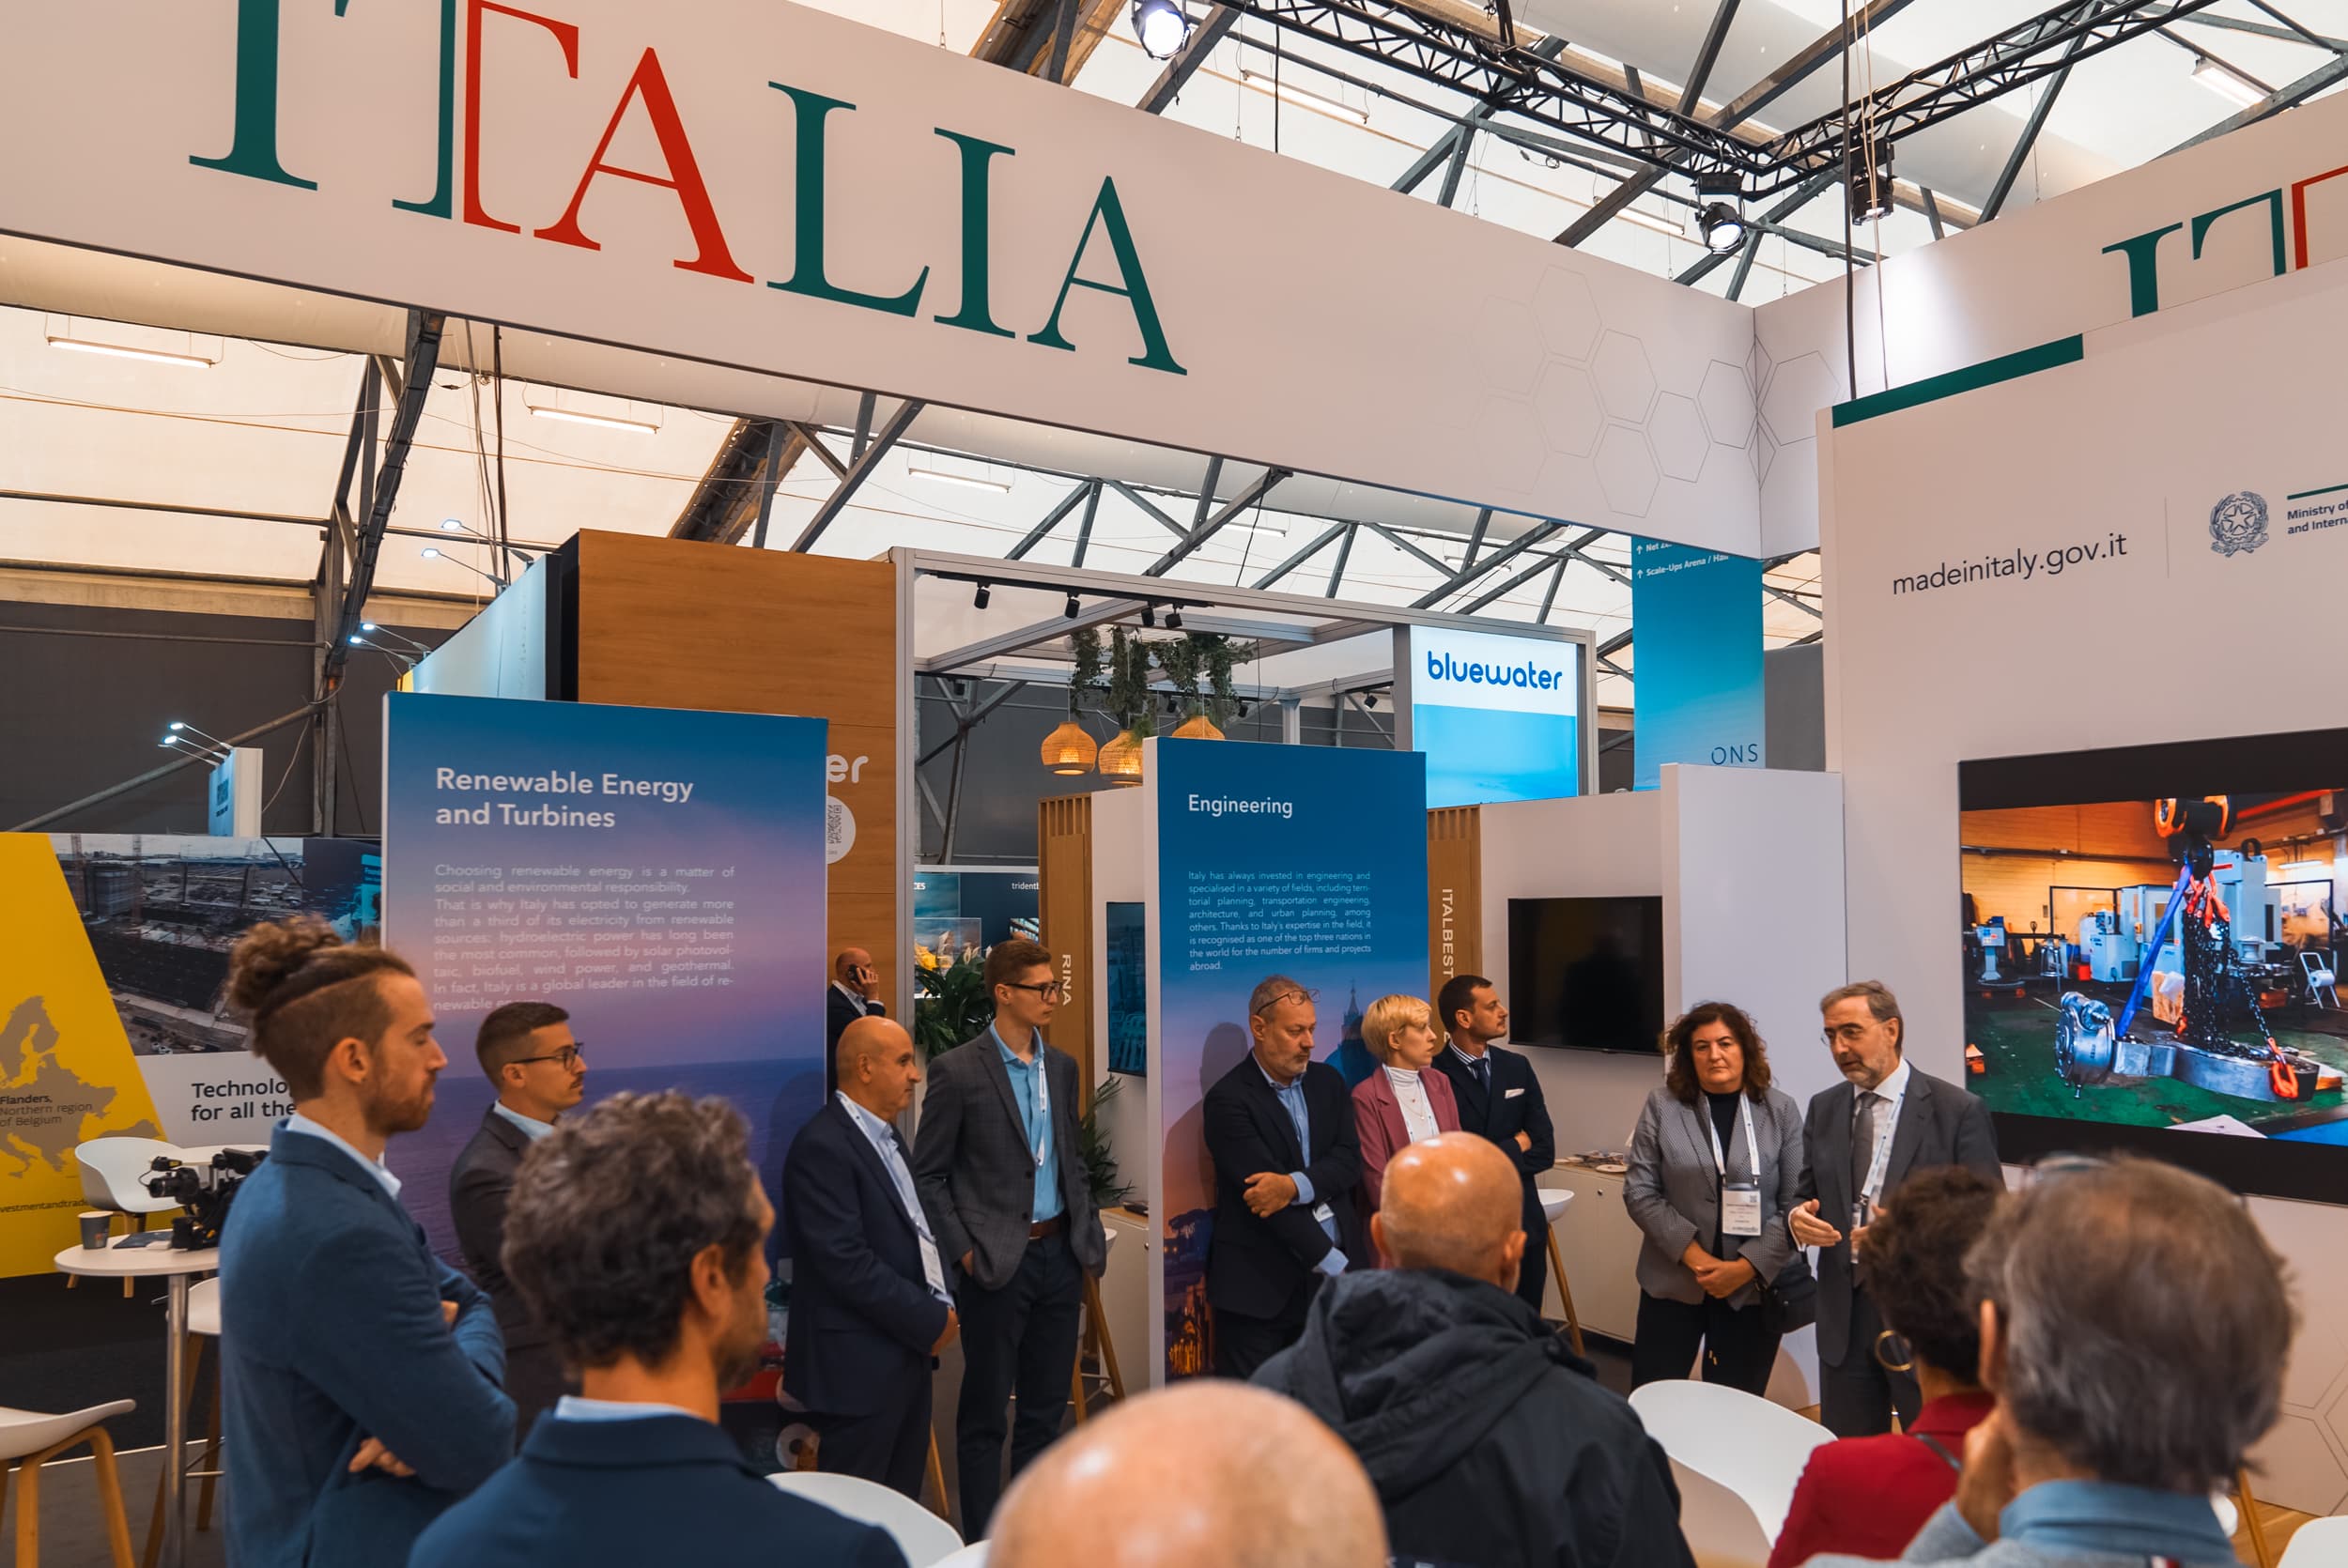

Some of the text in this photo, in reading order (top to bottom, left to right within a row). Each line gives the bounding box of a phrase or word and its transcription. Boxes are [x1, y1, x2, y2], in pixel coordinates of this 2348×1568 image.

[189, 0, 1187, 377] ITALIA
[2287, 503, 2335, 520] Ministry
[2287, 522, 2309, 534] and
[1645, 561, 1682, 576] Scale-Ups
[1684, 557, 1707, 568] Arena
[1892, 532, 2127, 595] madeinitaly.gov.it
[1428, 650, 1563, 690] bluewater
[1711, 743, 1758, 765] ONS
[436, 767, 694, 803] Renewable Energy
[1188, 794, 1293, 819] Engineering
[436, 802, 615, 828] and Turbines
[435, 864, 735, 879] Choosing renewable energy is a matter of
[1188, 871, 1370, 883] Italy has always invested in engineering and
[435, 881, 690, 895] social and environmental responsibility.
[1188, 883, 1235, 895] specialised
[1253, 884, 1280, 894] variety
[1281, 884, 1290, 892] of
[1316, 883, 1352, 894] including
[435, 898, 734, 913] That is why Italy has opted to generate more
[1188, 896, 1211, 906] torial
[1262, 897, 1317, 906] transportation
[435, 914, 734, 928] than a third of its electricity from renewable
[1247, 909, 1263, 917] and
[1271, 909, 1294, 917] urban
[1345, 909, 1371, 918] among
[1220, 921, 1249, 930] Thanks
[1285, 921, 1321, 930] expertise
[500, 930, 586, 945] hydroelectric
[594, 931, 634, 945] power
[641, 930, 662, 941] has
[669, 929, 697, 943] long
[703, 929, 734, 940] been
[1198, 934, 1244, 946] recognised
[1274, 933, 1283, 943] of
[1285, 932, 1297, 942] the
[1299, 933, 1312, 943] top
[1314, 931, 1334, 941] three
[433, 944, 734, 961] the most common, followed by solar photovol-
[1189, 945, 1371, 958] the world for the number of firms and projects
[533, 962, 565, 975] wind
[629, 961, 652, 973] and
[1190, 961, 1223, 971] abroad.
[433, 983, 447, 993] In
[484, 980, 513, 994] Italy
[517, 981, 526, 992] is
[530, 982, 538, 992] a
[543, 978, 584, 993] global
[588, 977, 629, 990] leader
[632, 977, 644, 987] in
[648, 976, 669, 987] the
[672, 975, 699, 987] field
[702, 975, 714, 986] of
[718, 976, 734, 986] re-
[1062, 954, 1072, 1006] RINA
[434, 998, 492, 1010] newable
[56, 1102, 93, 1115] region
[192, 1104, 223, 1121] for
[230, 1101, 254, 1119] all
[15, 1115, 62, 1127] Belgium
